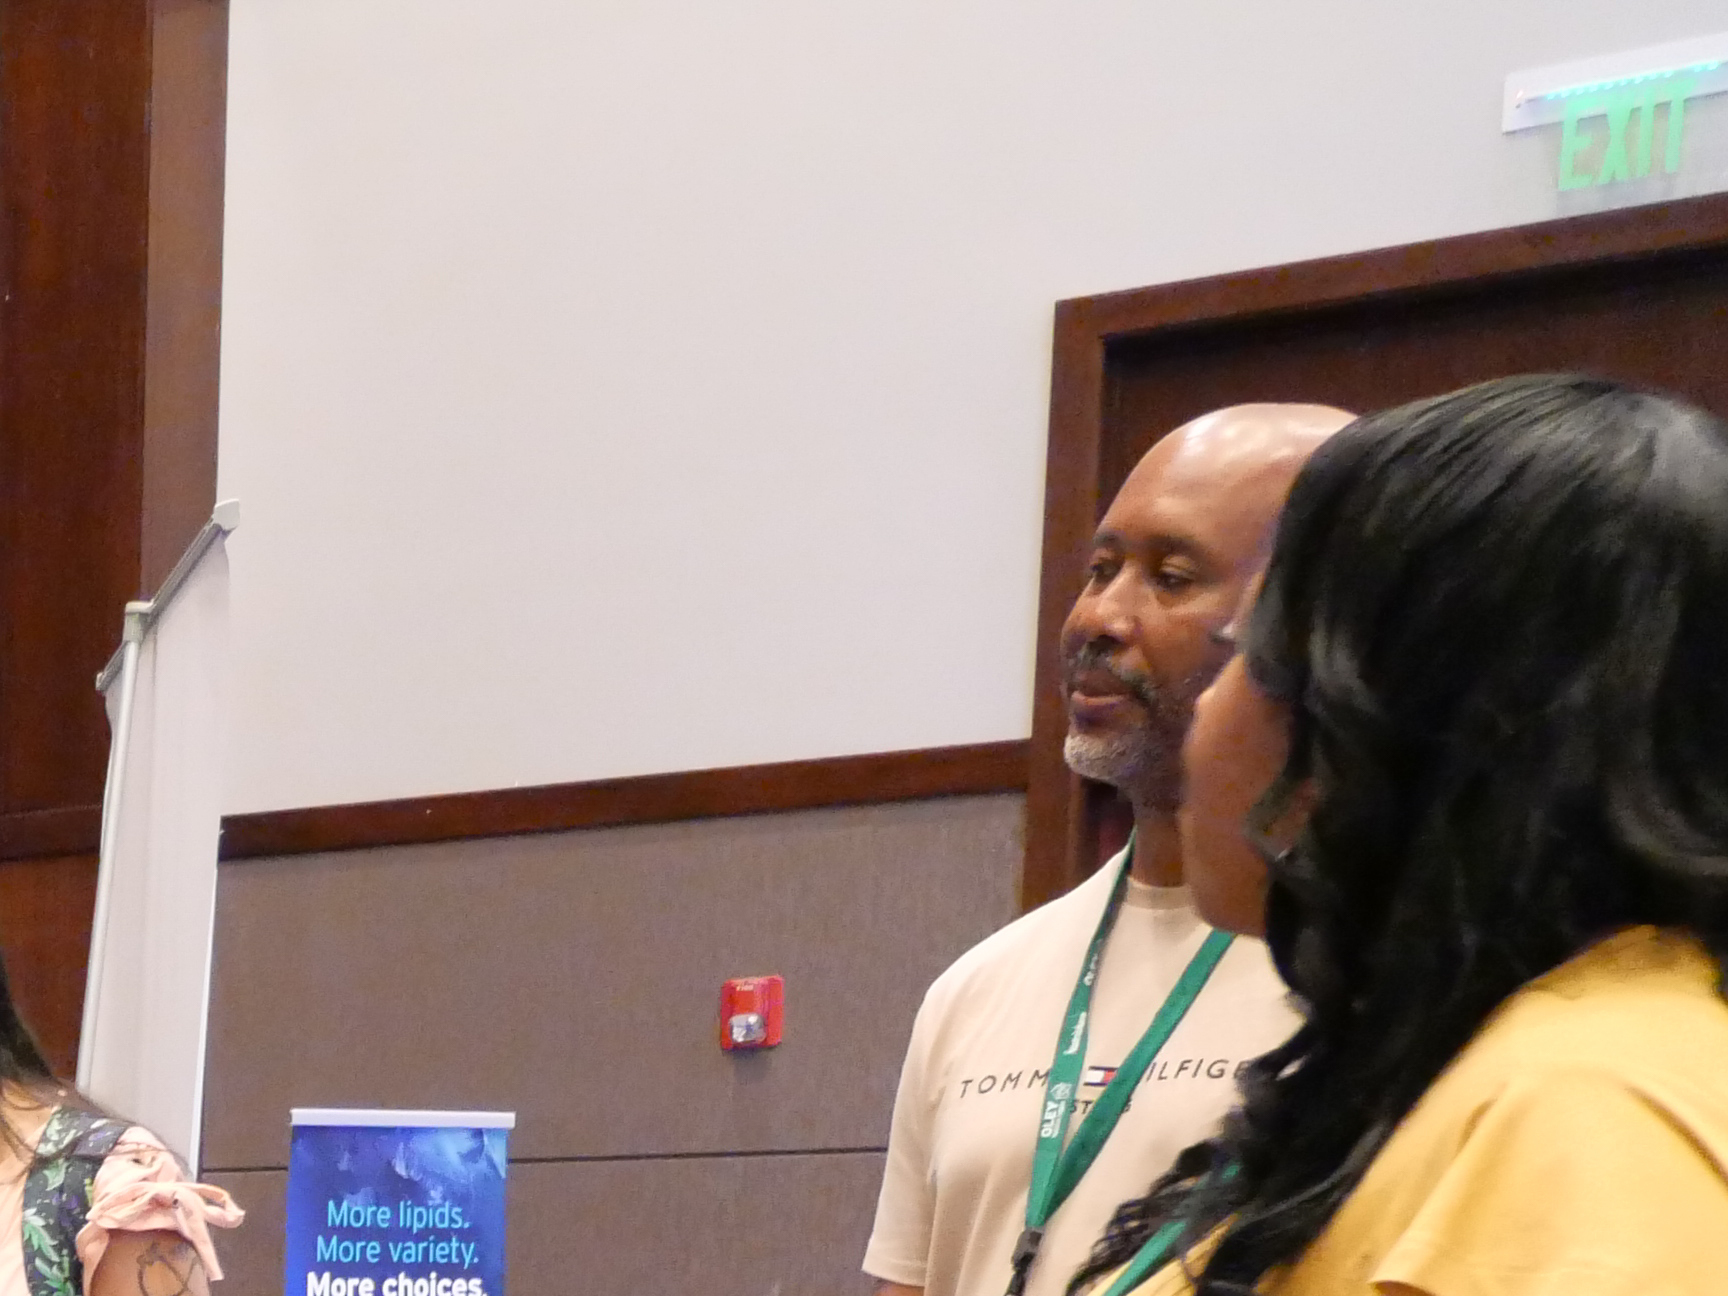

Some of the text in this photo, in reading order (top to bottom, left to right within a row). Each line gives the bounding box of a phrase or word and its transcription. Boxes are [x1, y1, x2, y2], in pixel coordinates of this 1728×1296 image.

[1557, 78, 1696, 191] EXIT
[327, 1200, 471, 1235] More lipids.
[316, 1235, 479, 1269] More variety.
